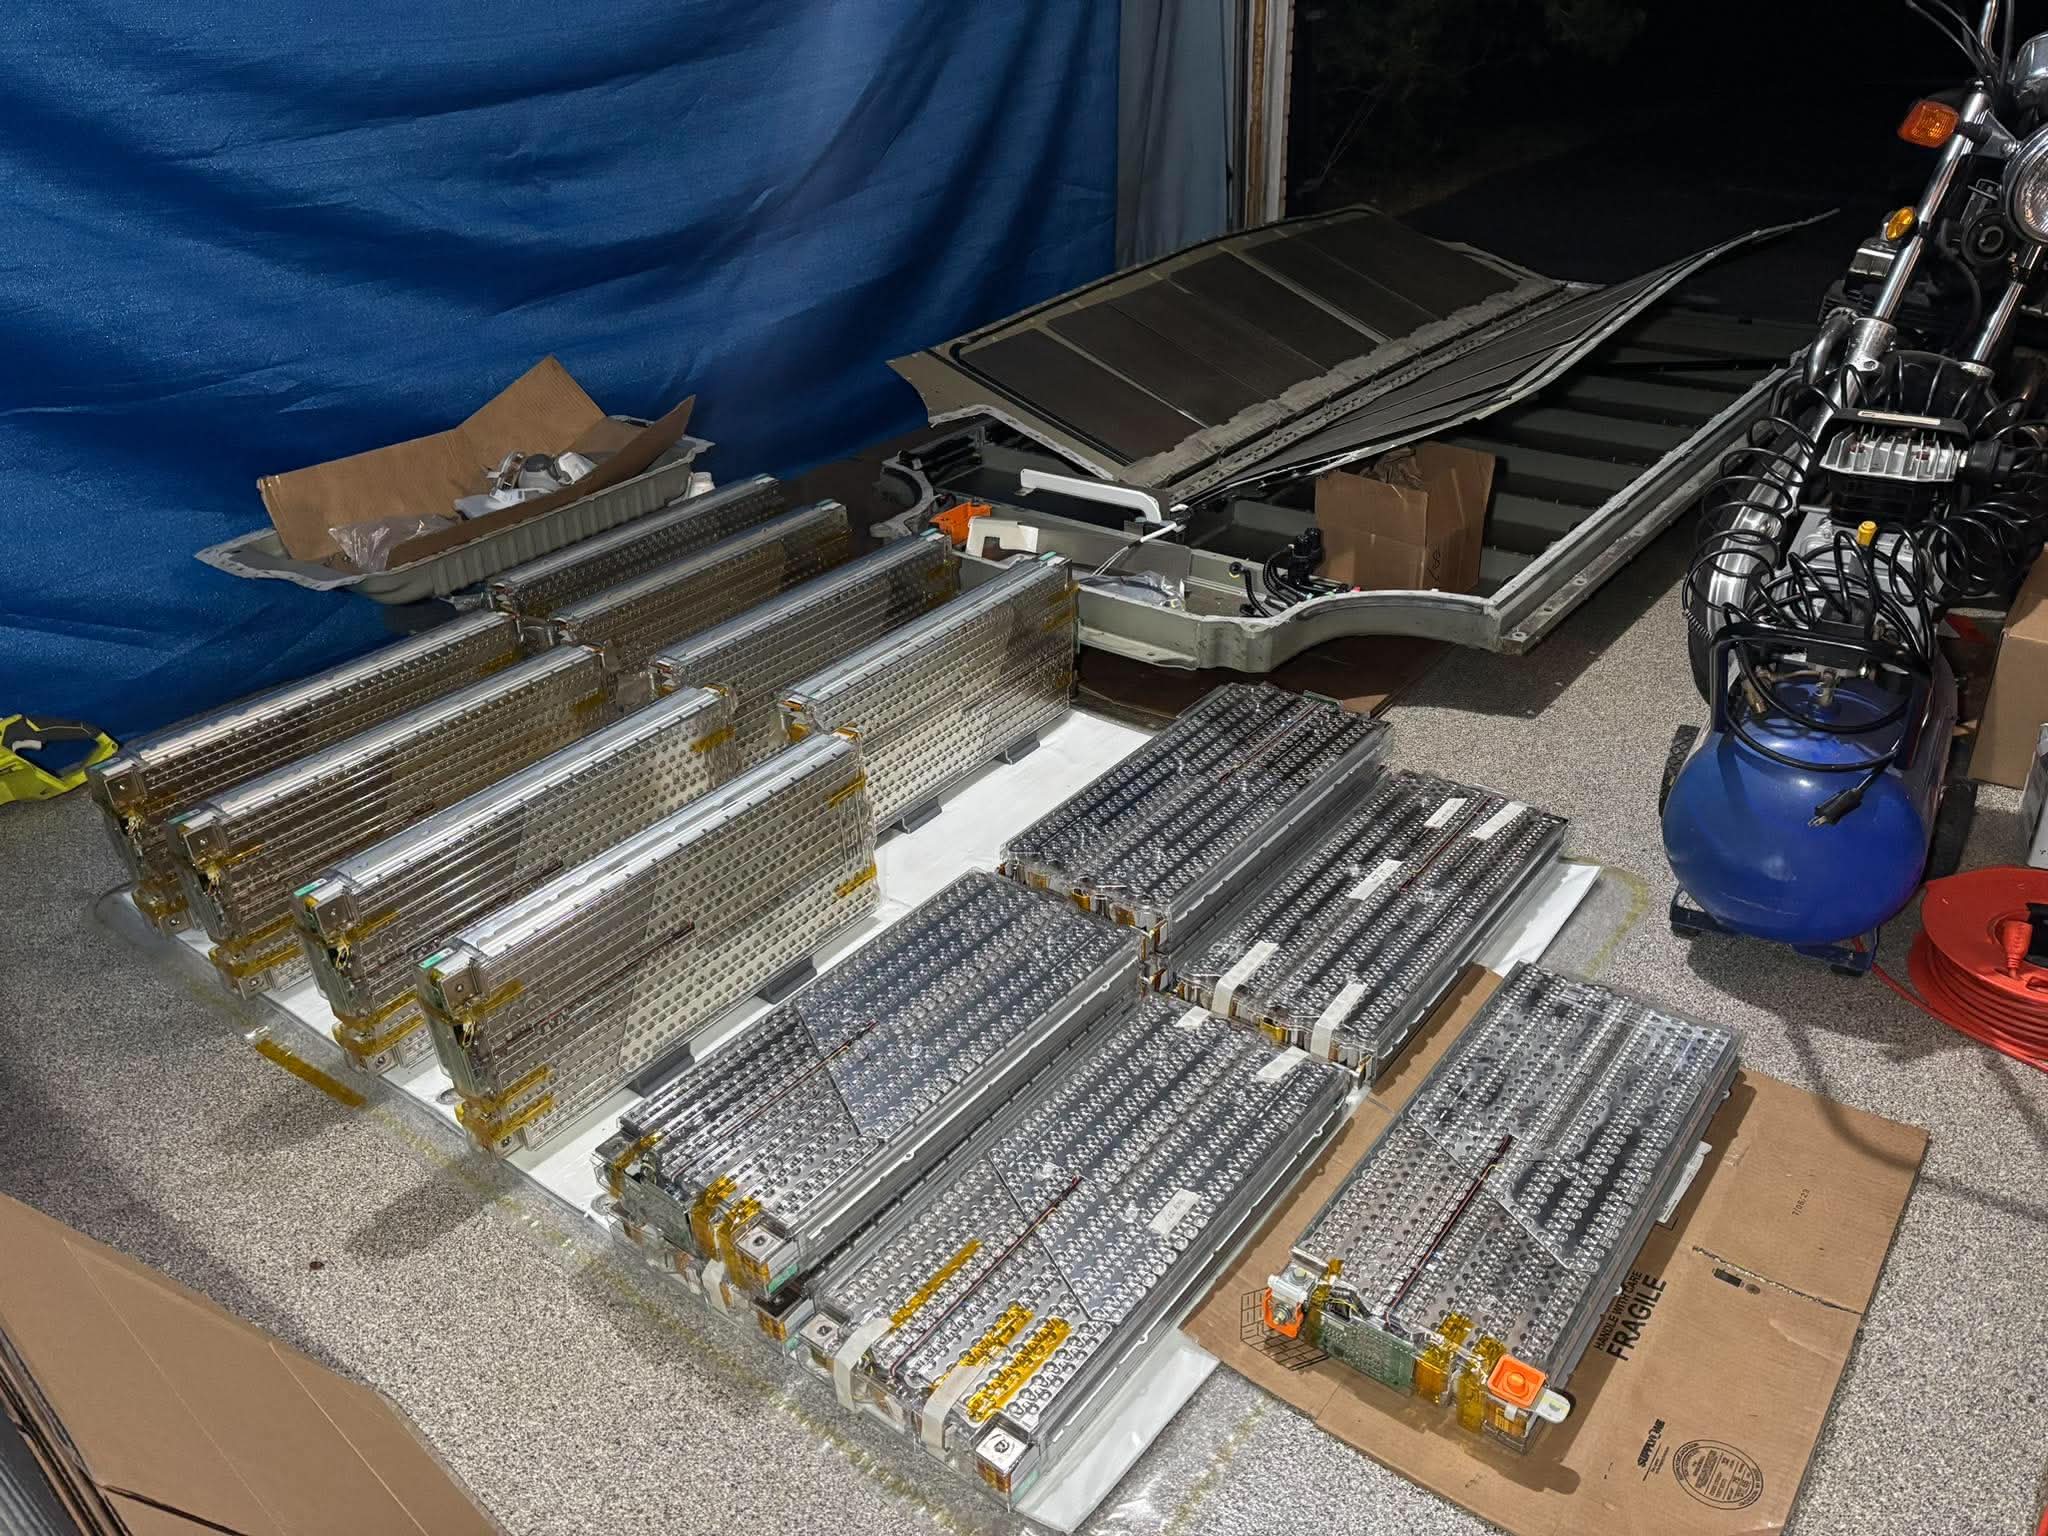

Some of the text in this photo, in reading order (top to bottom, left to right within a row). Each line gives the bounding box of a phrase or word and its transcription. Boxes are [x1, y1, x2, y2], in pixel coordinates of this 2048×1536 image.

[1593, 1271, 1643, 1351] HANDLE WITH CARE
[1606, 1275, 1668, 1361] FRAGILE
